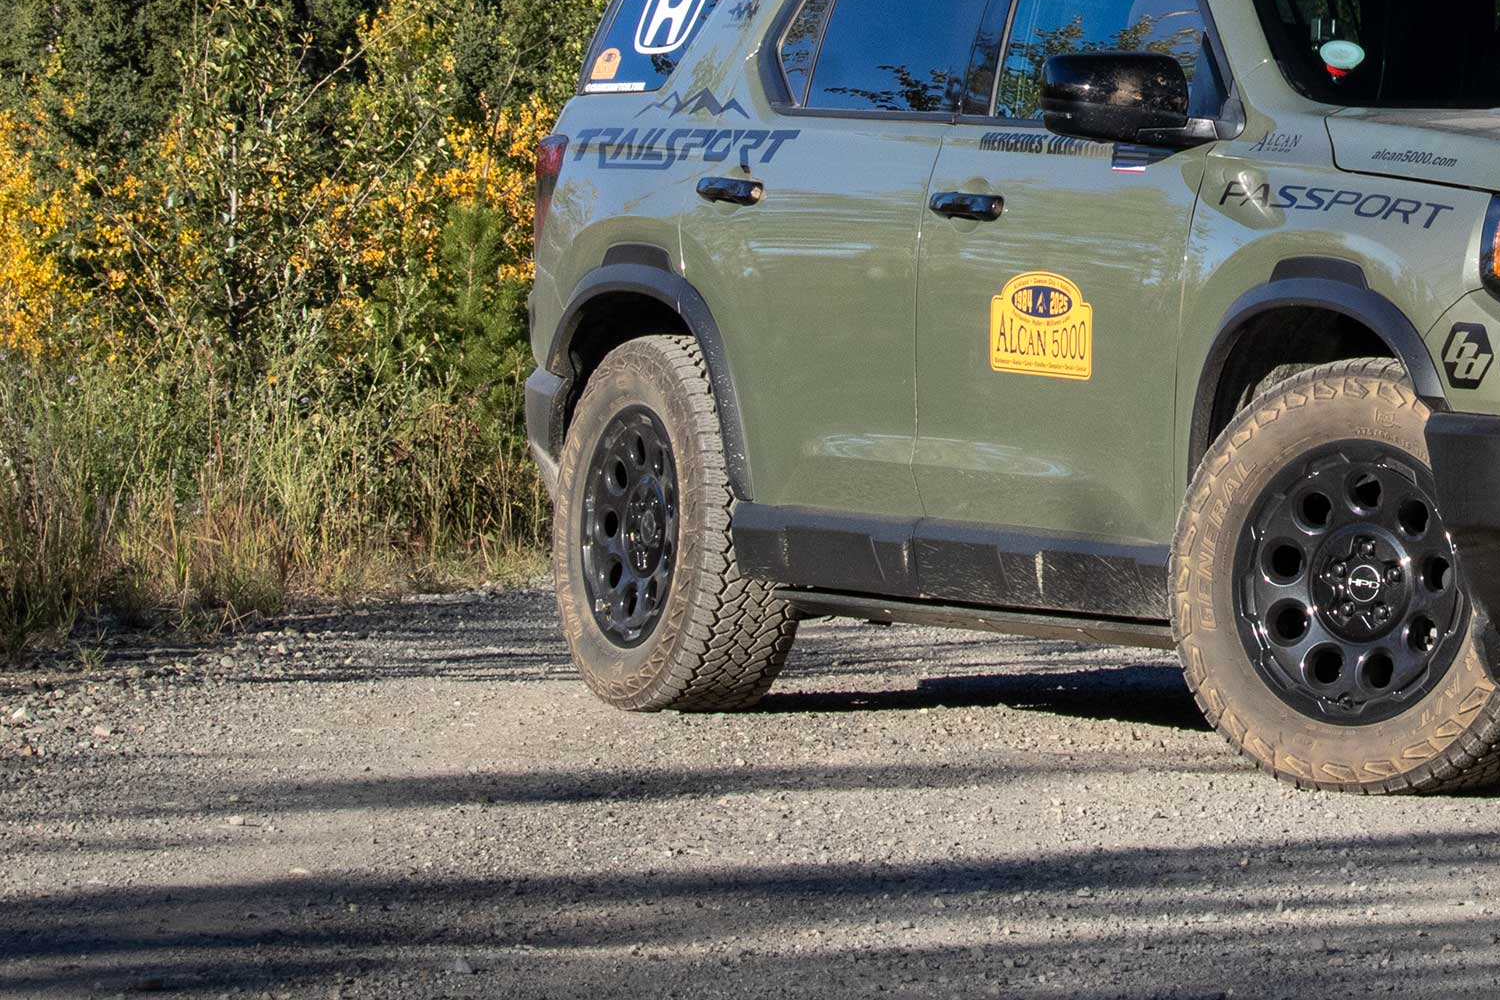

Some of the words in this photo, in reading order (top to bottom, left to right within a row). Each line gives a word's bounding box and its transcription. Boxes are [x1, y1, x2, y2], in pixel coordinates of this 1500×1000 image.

[573, 127, 801, 173] TRAILSPORT
[980, 132, 1048, 154] MERCEDES
[1249, 131, 1302, 151] ALCAN
[1371, 149, 1458, 168] alcan5000.com
[1218, 181, 1454, 229] PASSPORT
[1014, 289, 1032, 313] 1984
[1050, 291, 1069, 315] 2025
[997, 311, 1047, 357] ALCAN
[1051, 320, 1087, 361] 5000
[1199, 462, 1258, 631] GENERAL
[1348, 577, 1380, 588] HPD
